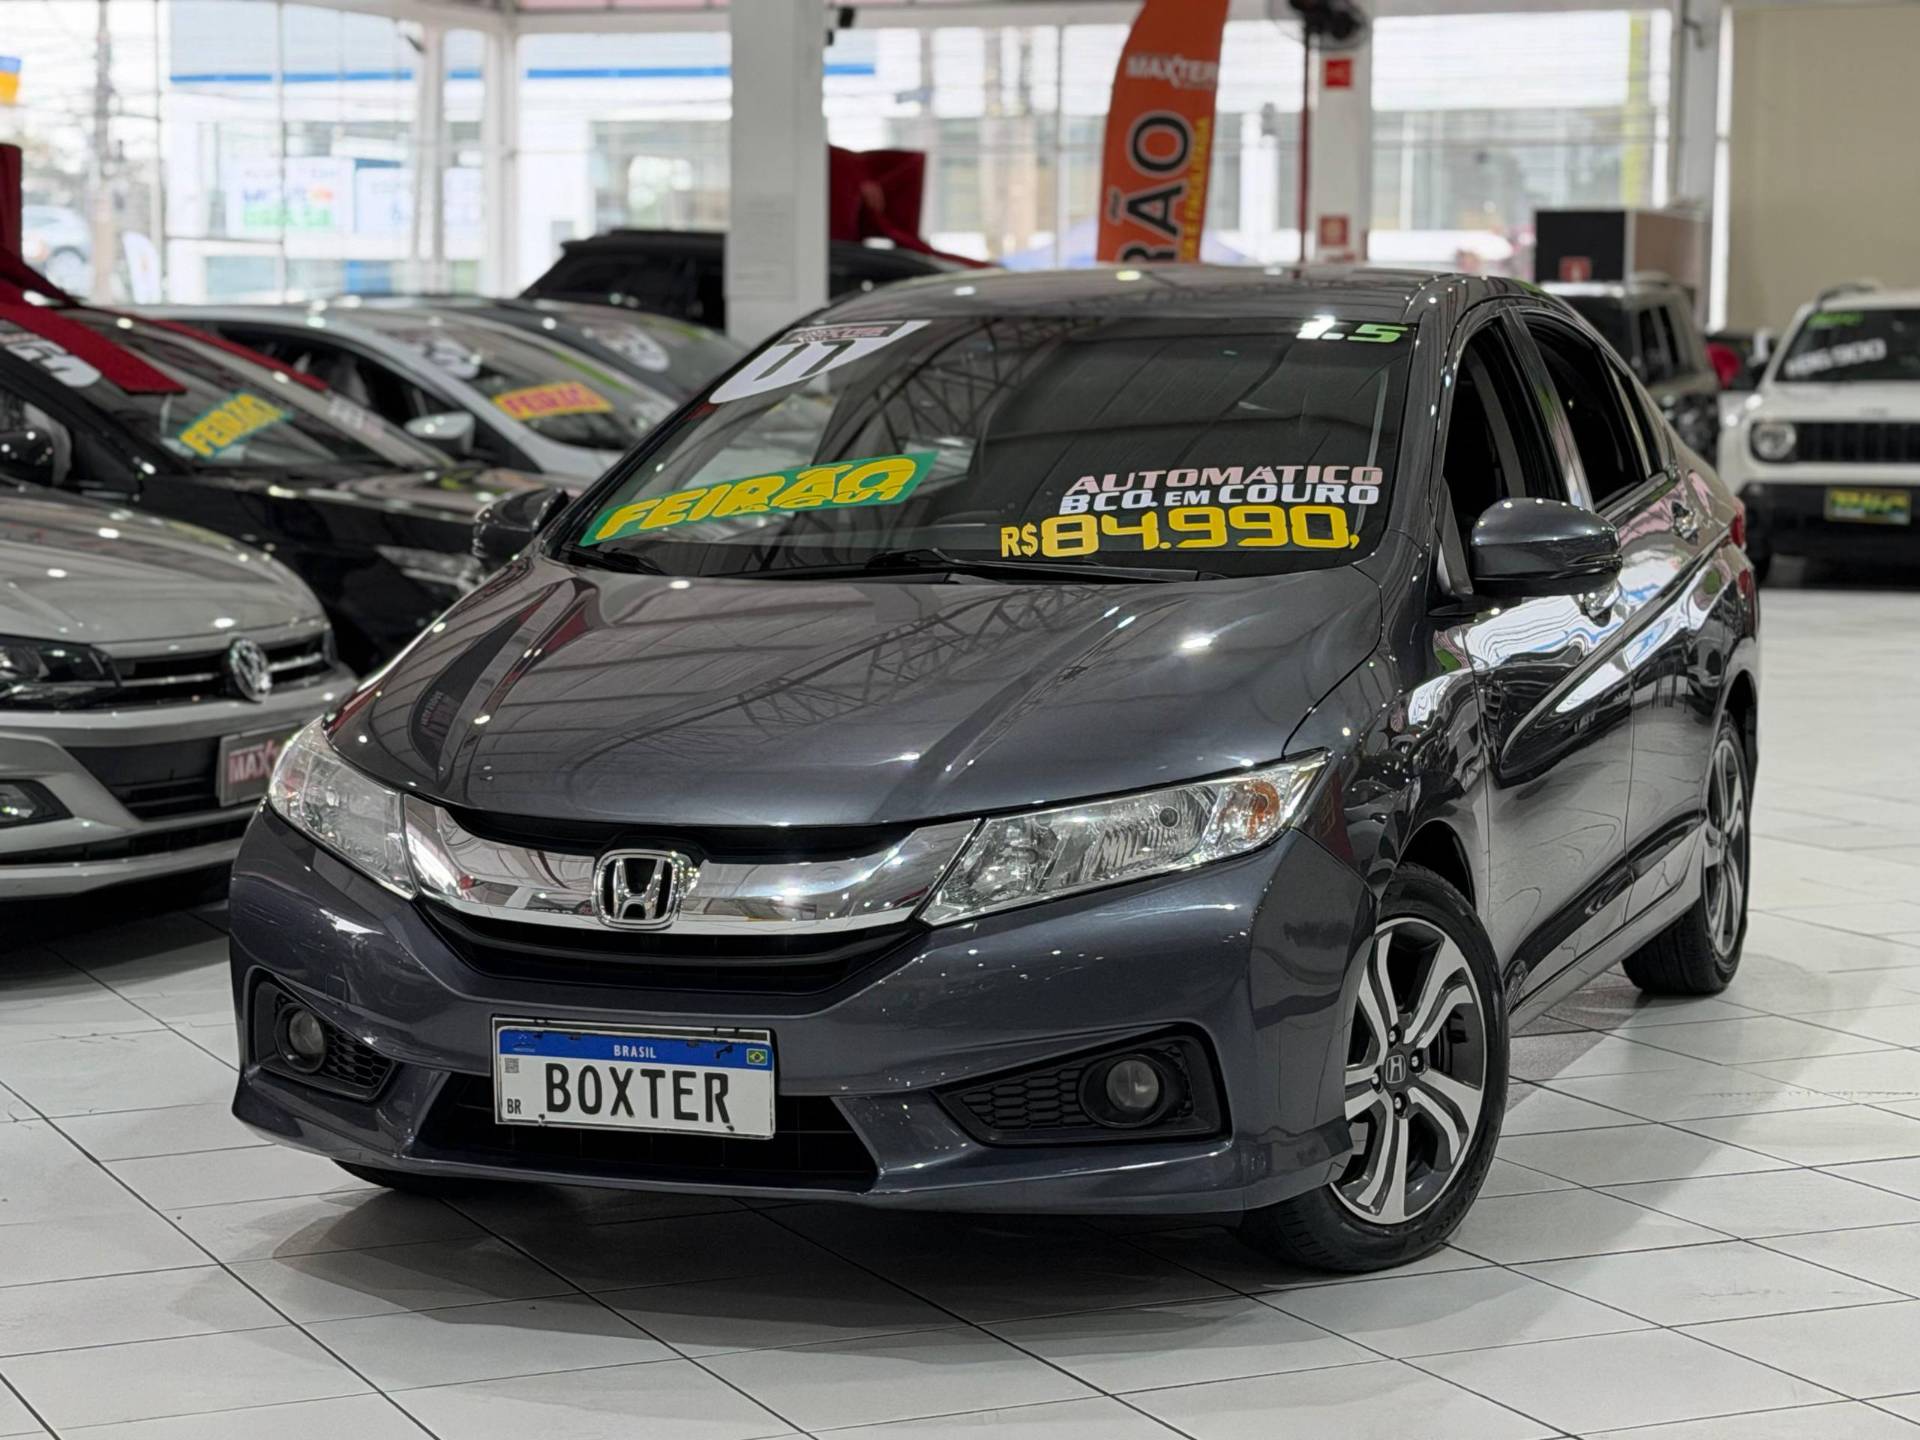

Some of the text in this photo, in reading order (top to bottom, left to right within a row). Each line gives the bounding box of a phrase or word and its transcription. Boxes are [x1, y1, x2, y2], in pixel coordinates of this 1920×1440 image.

[595, 458, 917, 541] FEIRÃO
[1164, 490, 1211, 507] EM
[1218, 484, 1379, 505] COURO
[613, 1044, 657, 1060] BRASIL
[545, 1062, 731, 1124] BOXTER
[506, 1098, 523, 1115] BR
